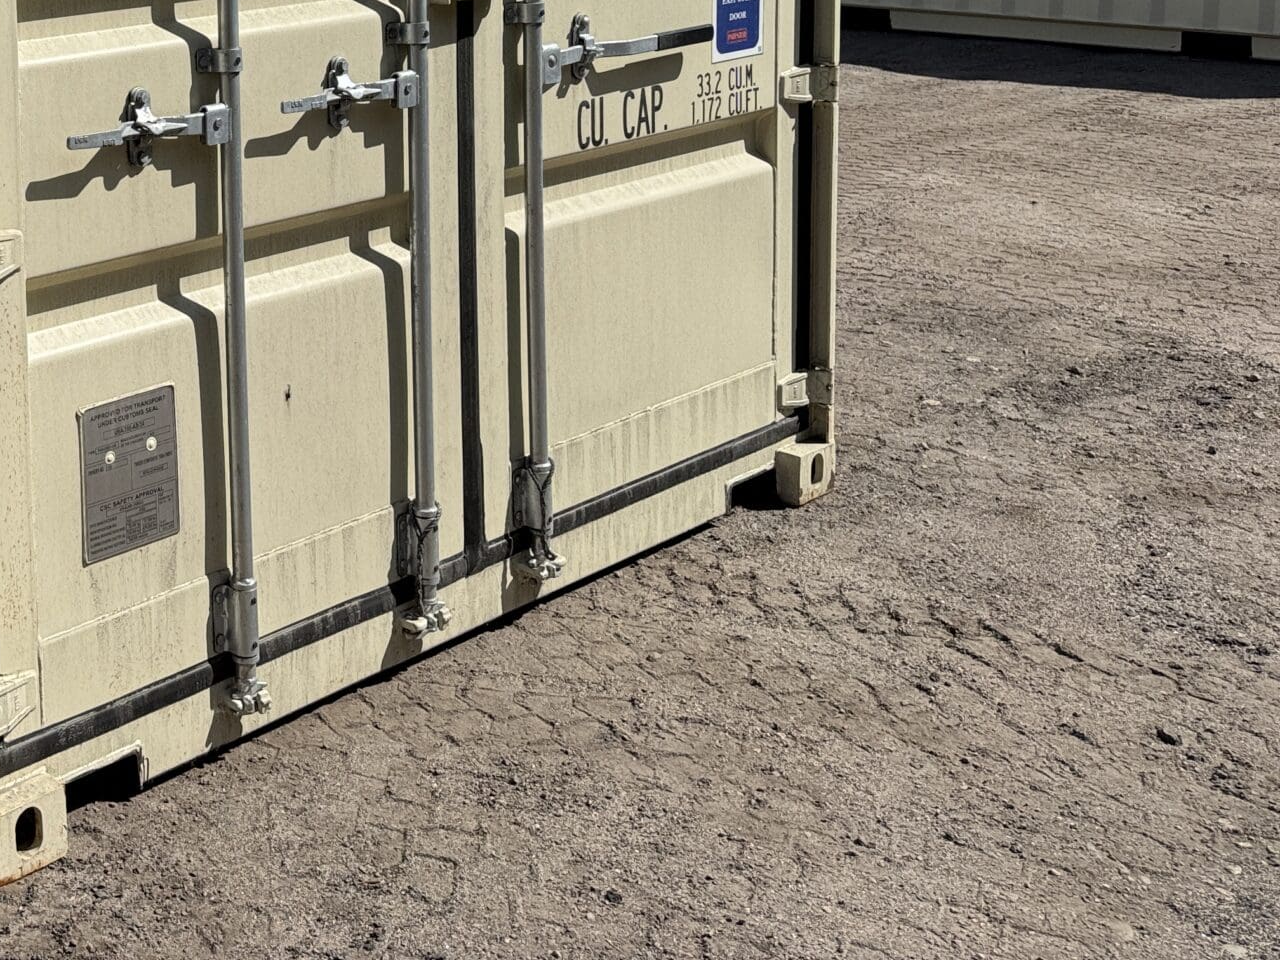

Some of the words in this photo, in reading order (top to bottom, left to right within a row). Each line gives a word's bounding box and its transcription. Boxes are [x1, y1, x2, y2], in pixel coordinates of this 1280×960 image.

[729, 11, 747, 21] DOOR
[697, 71, 721, 98] 33.2
[577, 96, 608, 150] CU.
[623, 85, 668, 139] CAP.
[691, 96, 721, 126] 1,172
